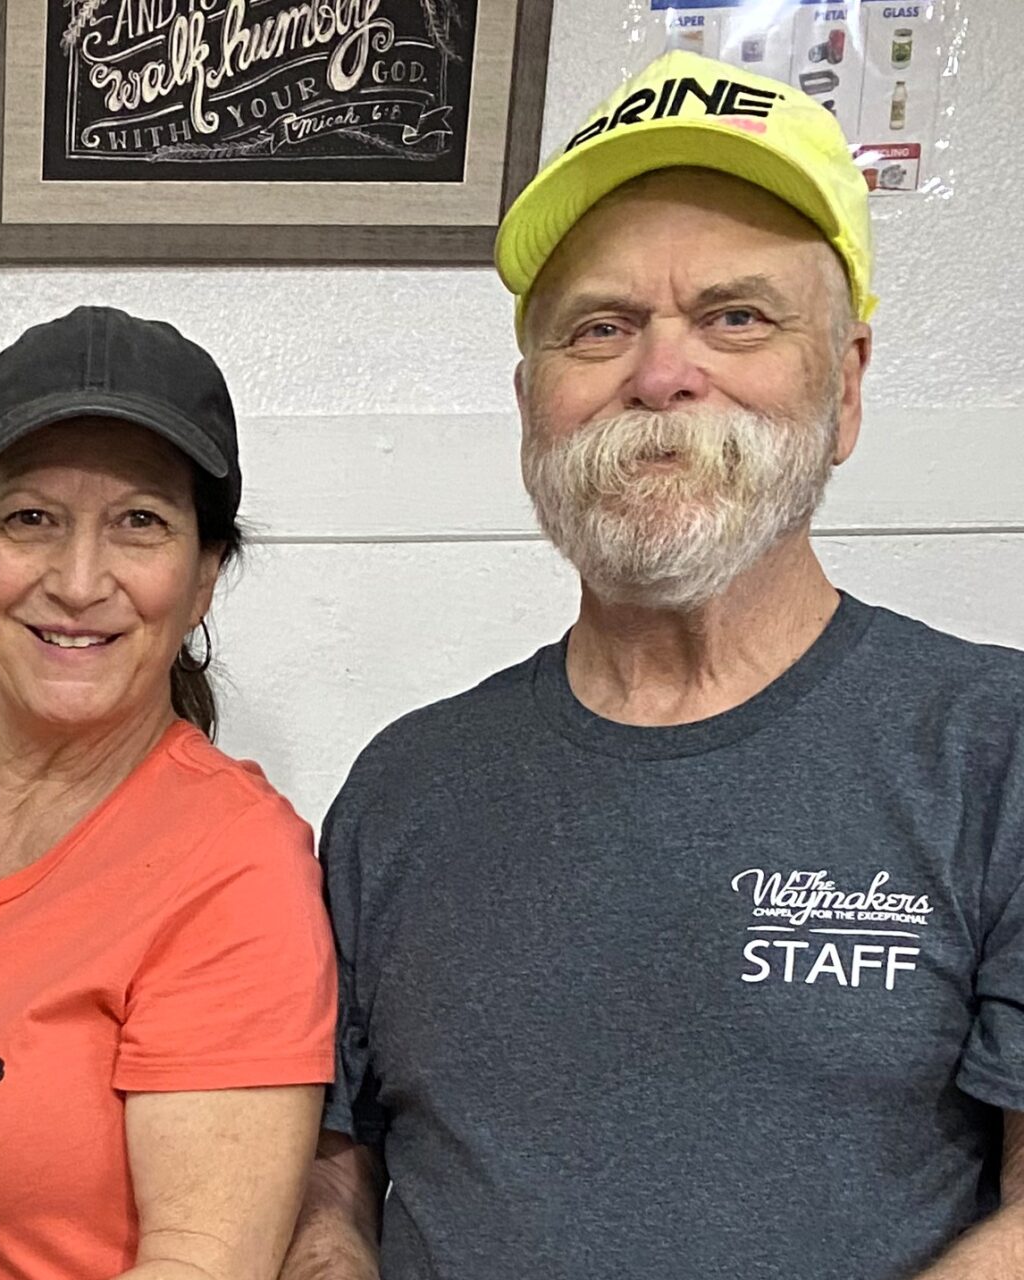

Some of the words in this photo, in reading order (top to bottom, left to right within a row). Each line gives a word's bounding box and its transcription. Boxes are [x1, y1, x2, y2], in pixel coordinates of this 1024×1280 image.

[672, 16, 705, 27] APER
[882, 6, 920, 19] GLASS
[89, 11, 220, 134] walk
[205, 0, 395, 92] humbly
[108, 119, 192, 149] WITH
[227, 77, 319, 128] YOUR
[371, 60, 428, 84] GOD.
[371, 104, 402, 120] 6:8
[793, 870, 836, 891] The
[731, 868, 934, 926] Waymakers
[752, 907, 793, 918] CHAPEL
[810, 909, 833, 919] FOR
[834, 910, 855, 920] THE
[857, 910, 928, 925] EXCEPTIONAL
[741, 938, 921, 991] STAFF
